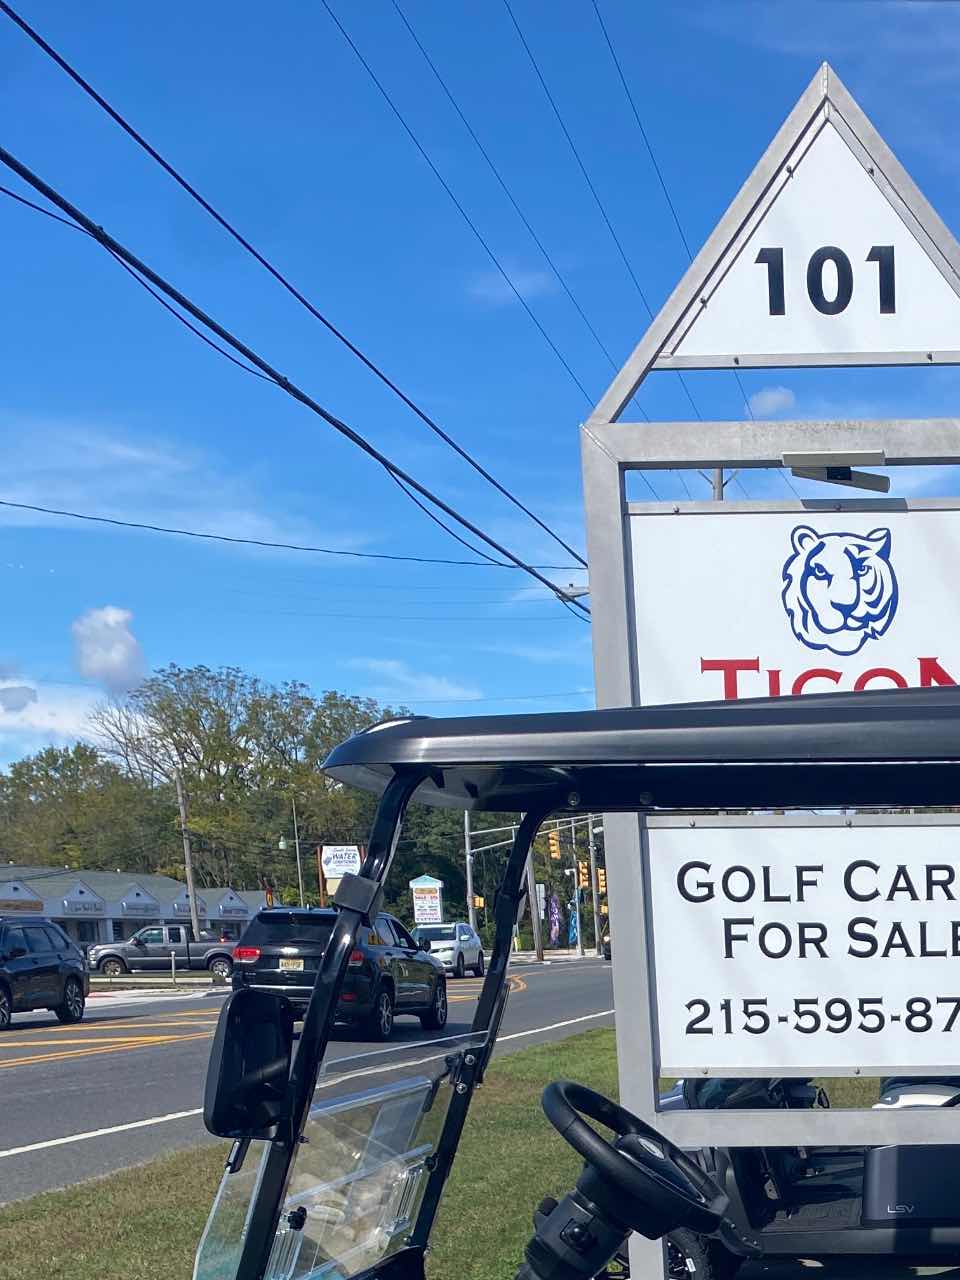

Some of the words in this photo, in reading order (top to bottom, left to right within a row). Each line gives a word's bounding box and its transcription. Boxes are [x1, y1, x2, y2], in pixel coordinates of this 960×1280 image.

[754, 245, 896, 316] 101
[676, 860, 824, 904] GOLF
[722, 917, 829, 959] FOR
[887, 1204, 914, 1214] LSV
